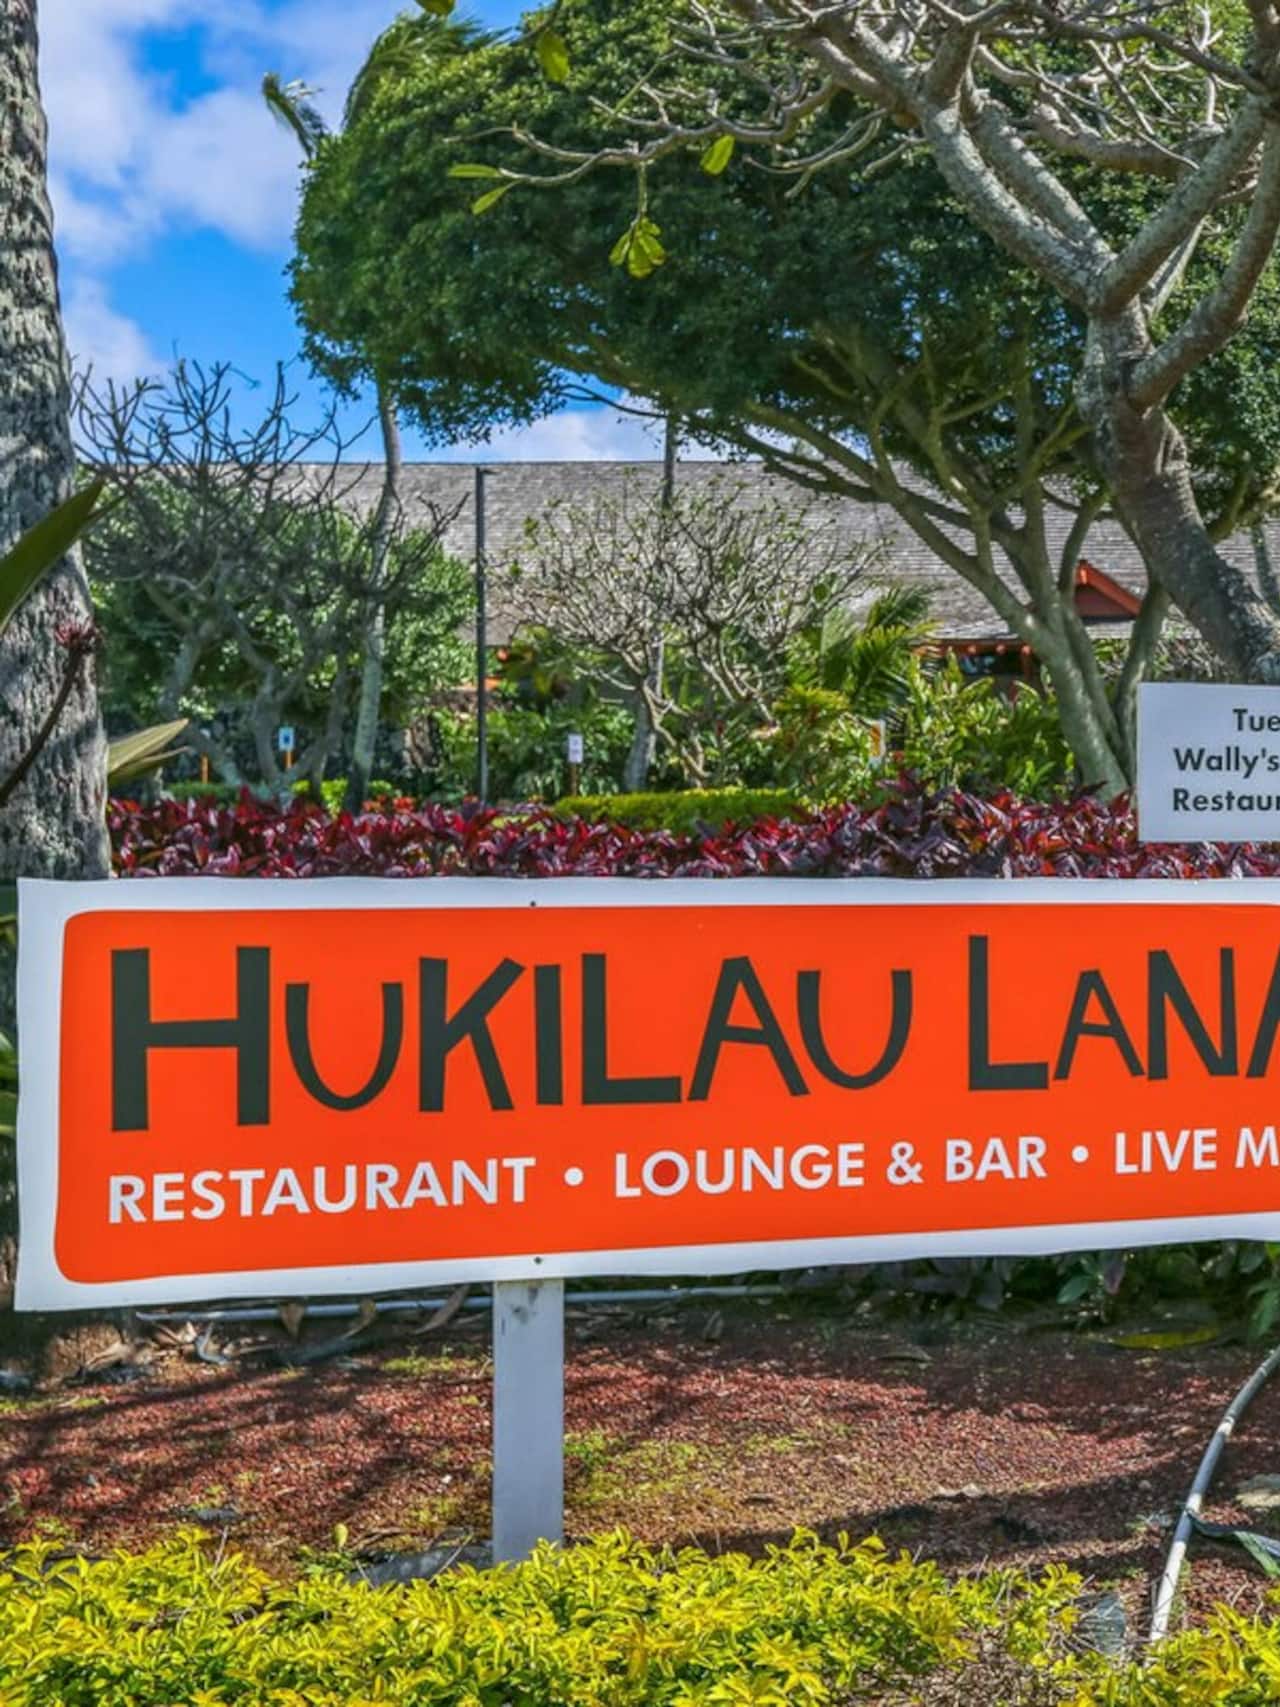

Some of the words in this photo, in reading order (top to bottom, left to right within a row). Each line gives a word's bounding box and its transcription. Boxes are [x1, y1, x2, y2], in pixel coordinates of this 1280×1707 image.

[1173, 745, 1280, 780] Wally's
[111, 945, 913, 1132] HUKILAU
[108, 1156, 536, 1224] RESTAURANT
[615, 1142, 865, 1198] LOUNGE
[886, 1141, 923, 1185] &
[945, 1136, 1047, 1182] BAR
[1115, 1128, 1217, 1174] LIVE
